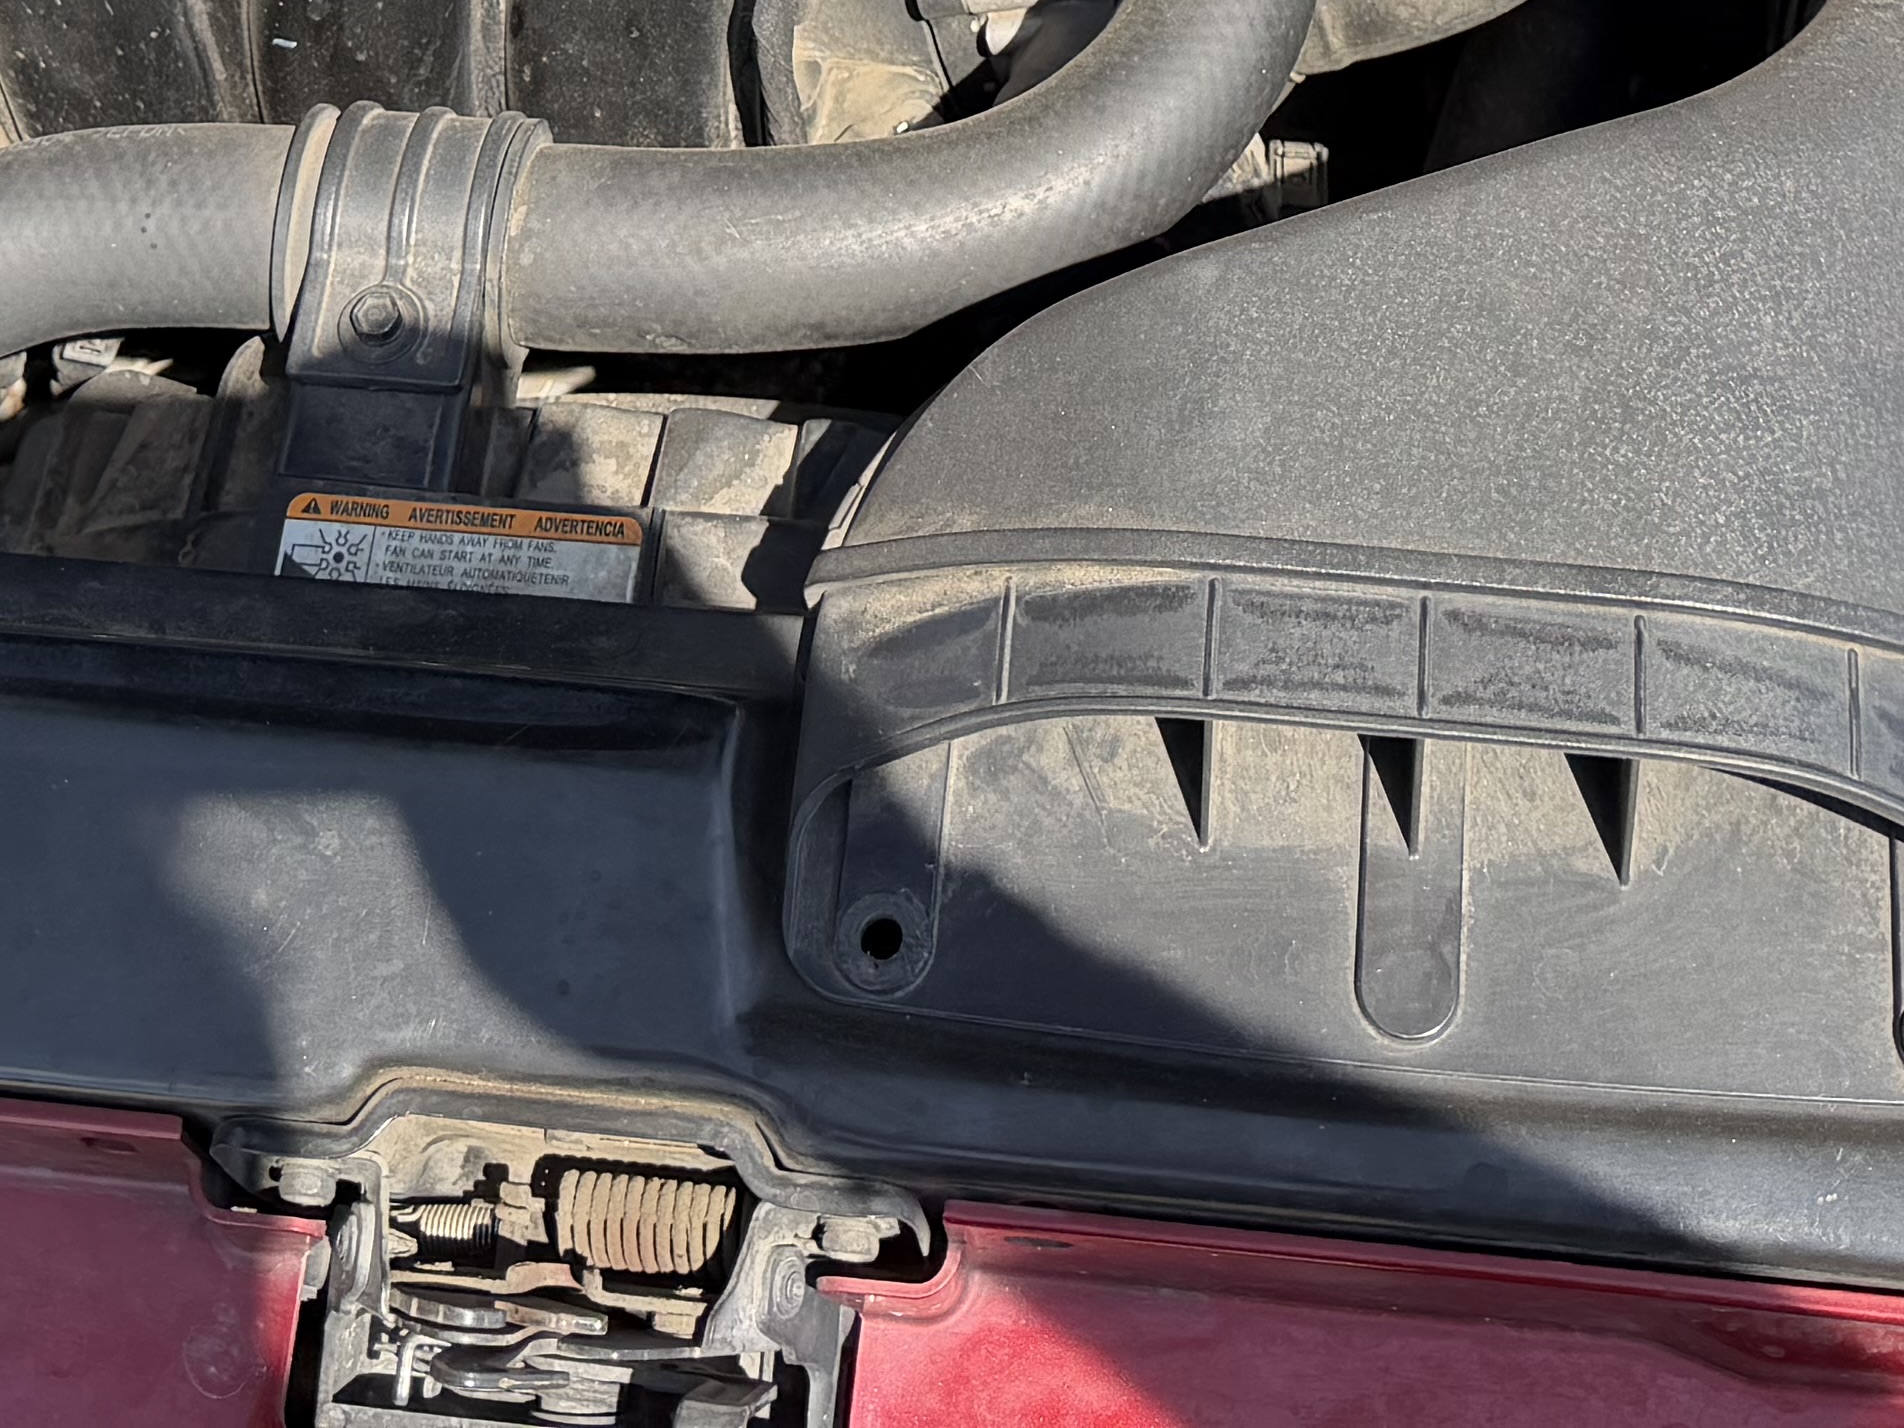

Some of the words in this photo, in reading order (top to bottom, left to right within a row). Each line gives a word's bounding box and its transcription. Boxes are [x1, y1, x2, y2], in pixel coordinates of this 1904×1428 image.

[330, 499, 390, 520] WARNING
[408, 506, 517, 530] AVERTISSEMENT
[533, 518, 626, 538] ADVERTENCIA
[387, 530, 415, 542] KEEP
[420, 533, 454, 545] HANDS
[457, 536, 489, 548] AWAY
[493, 537, 523, 550] FROM
[385, 545, 407, 558] FAN
[411, 547, 435, 559] CAN
[439, 549, 473, 563] START
[479, 552, 495, 564] AT
[498, 553, 522, 566] ANY
[382, 560, 455, 577] VENTILATEUR
